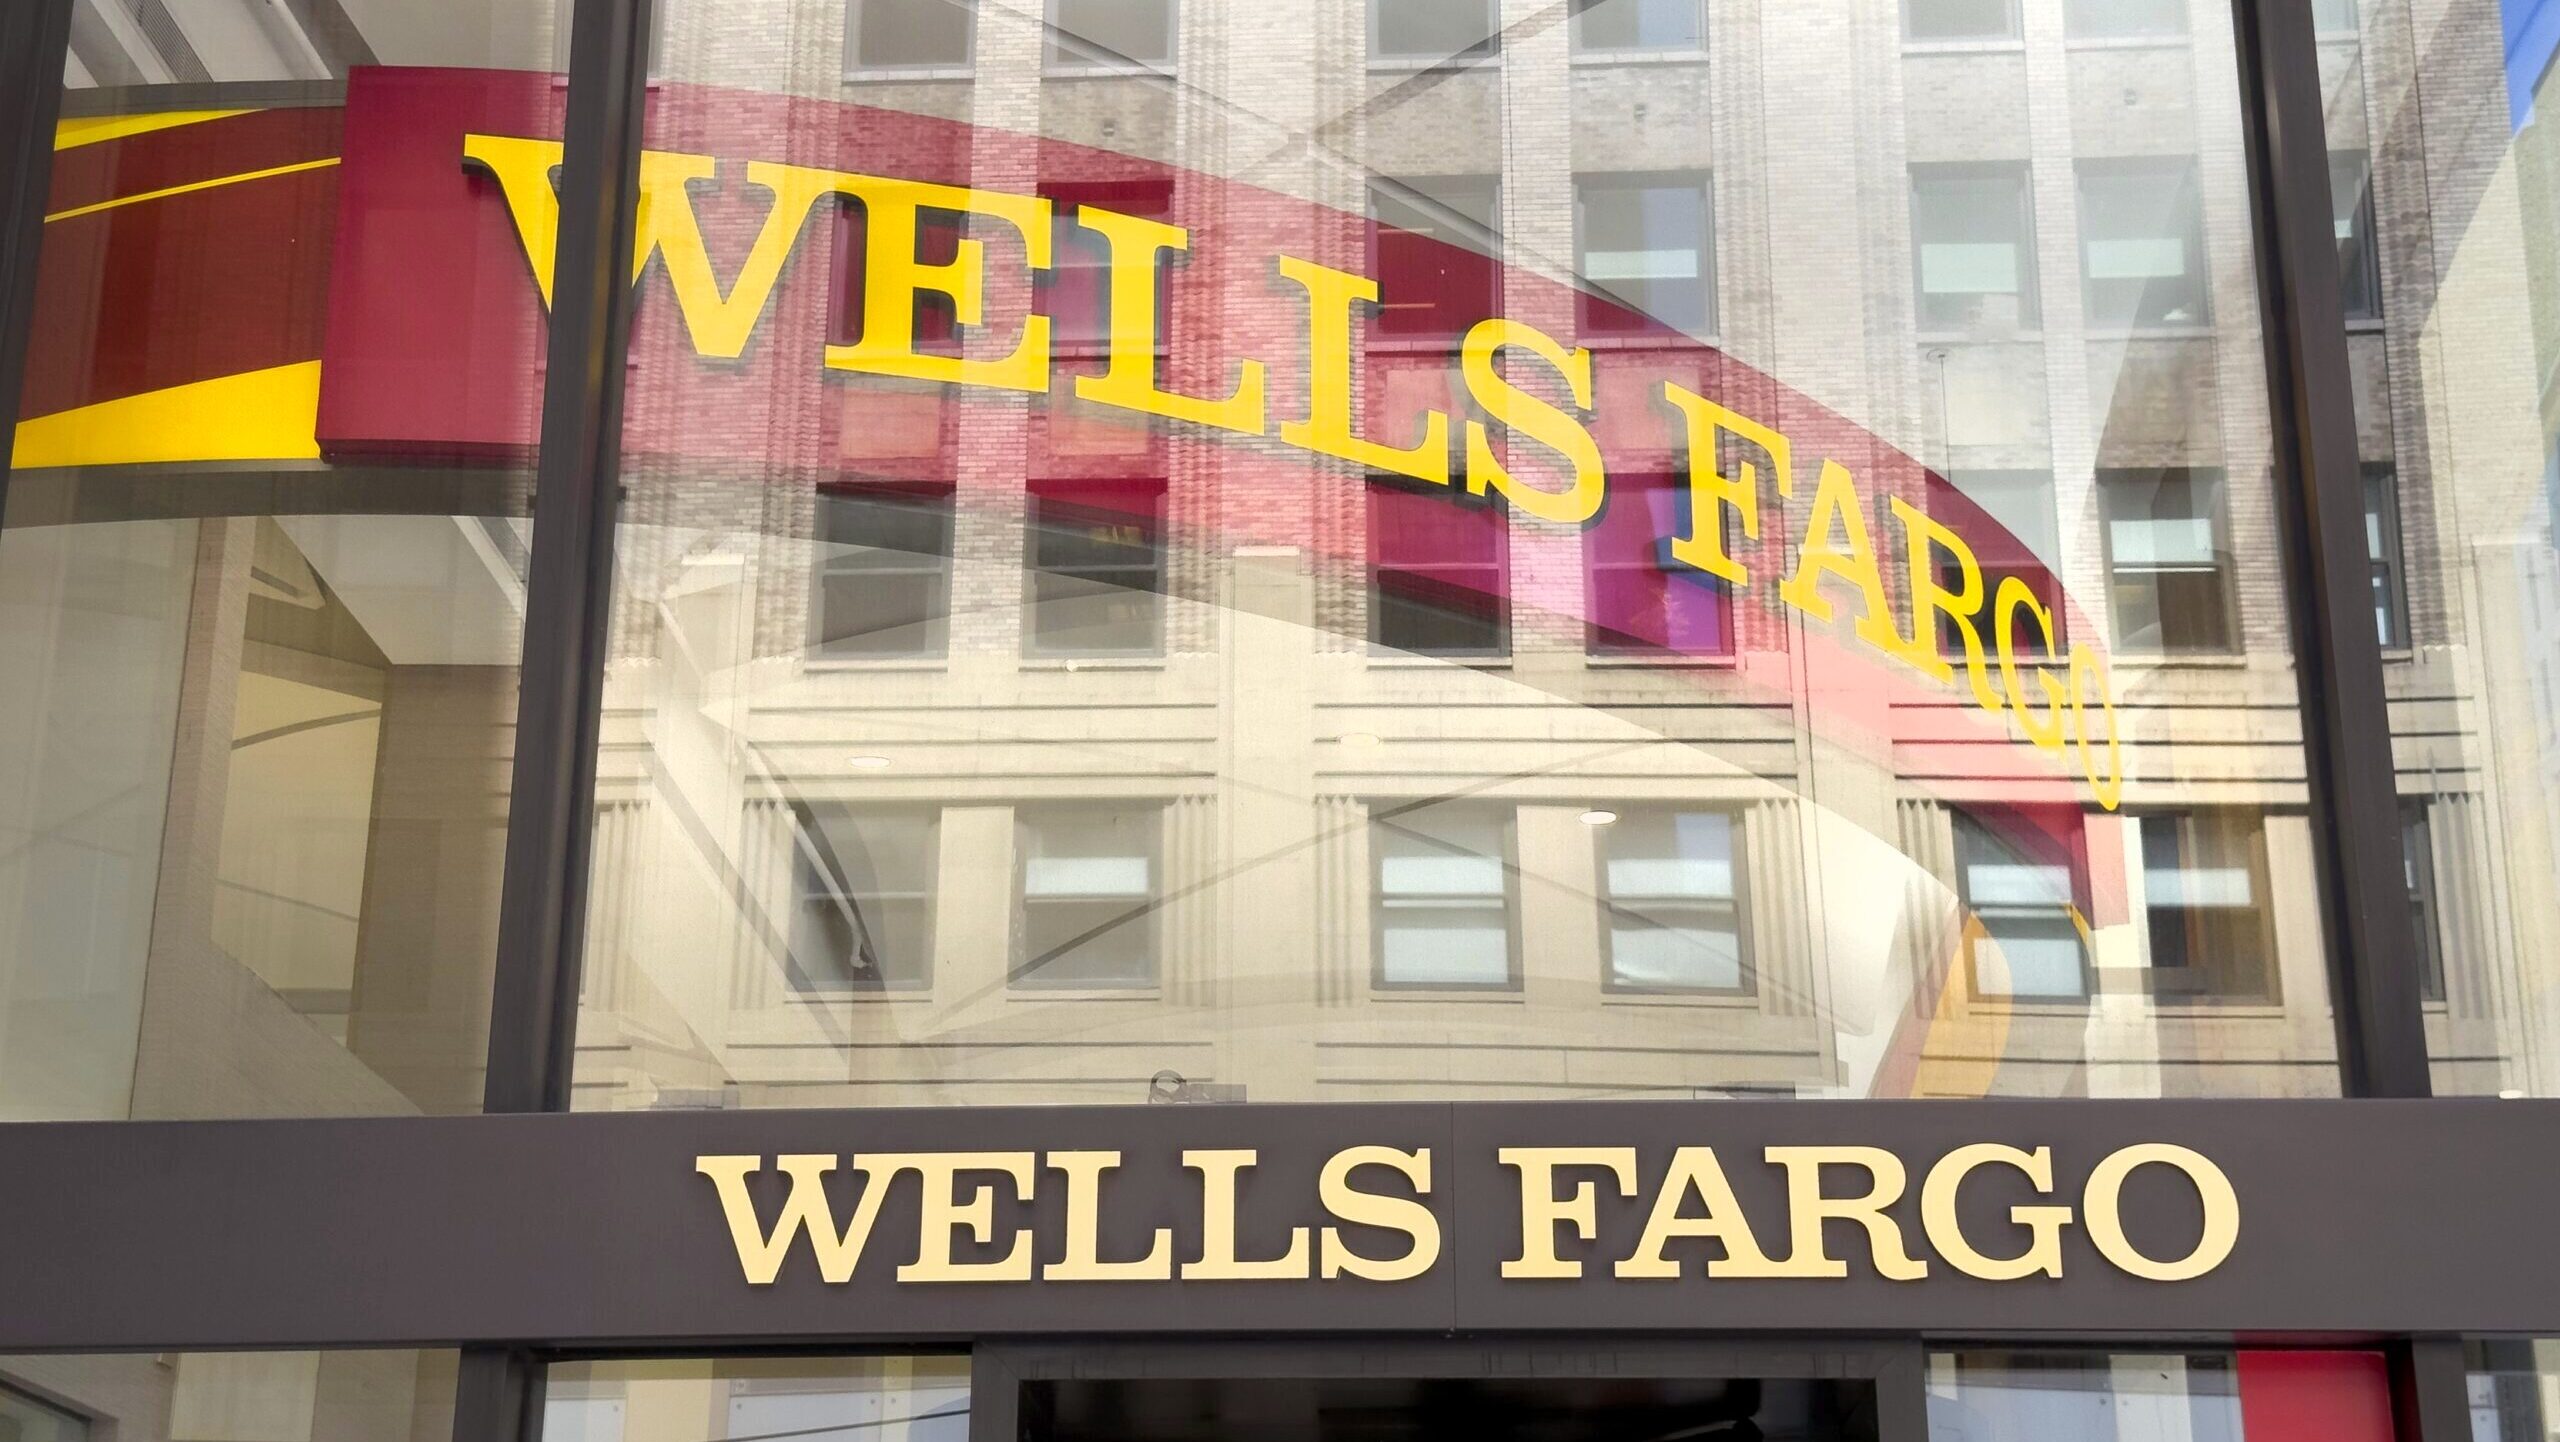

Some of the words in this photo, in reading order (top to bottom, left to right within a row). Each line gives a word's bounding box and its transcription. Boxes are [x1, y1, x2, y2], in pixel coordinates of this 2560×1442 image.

[463, 133, 1605, 523] WELLS
[1664, 381, 2121, 811] FARGO
[695, 1145, 1441, 1284] WELLS
[1499, 1142, 2240, 1281] FARGO
